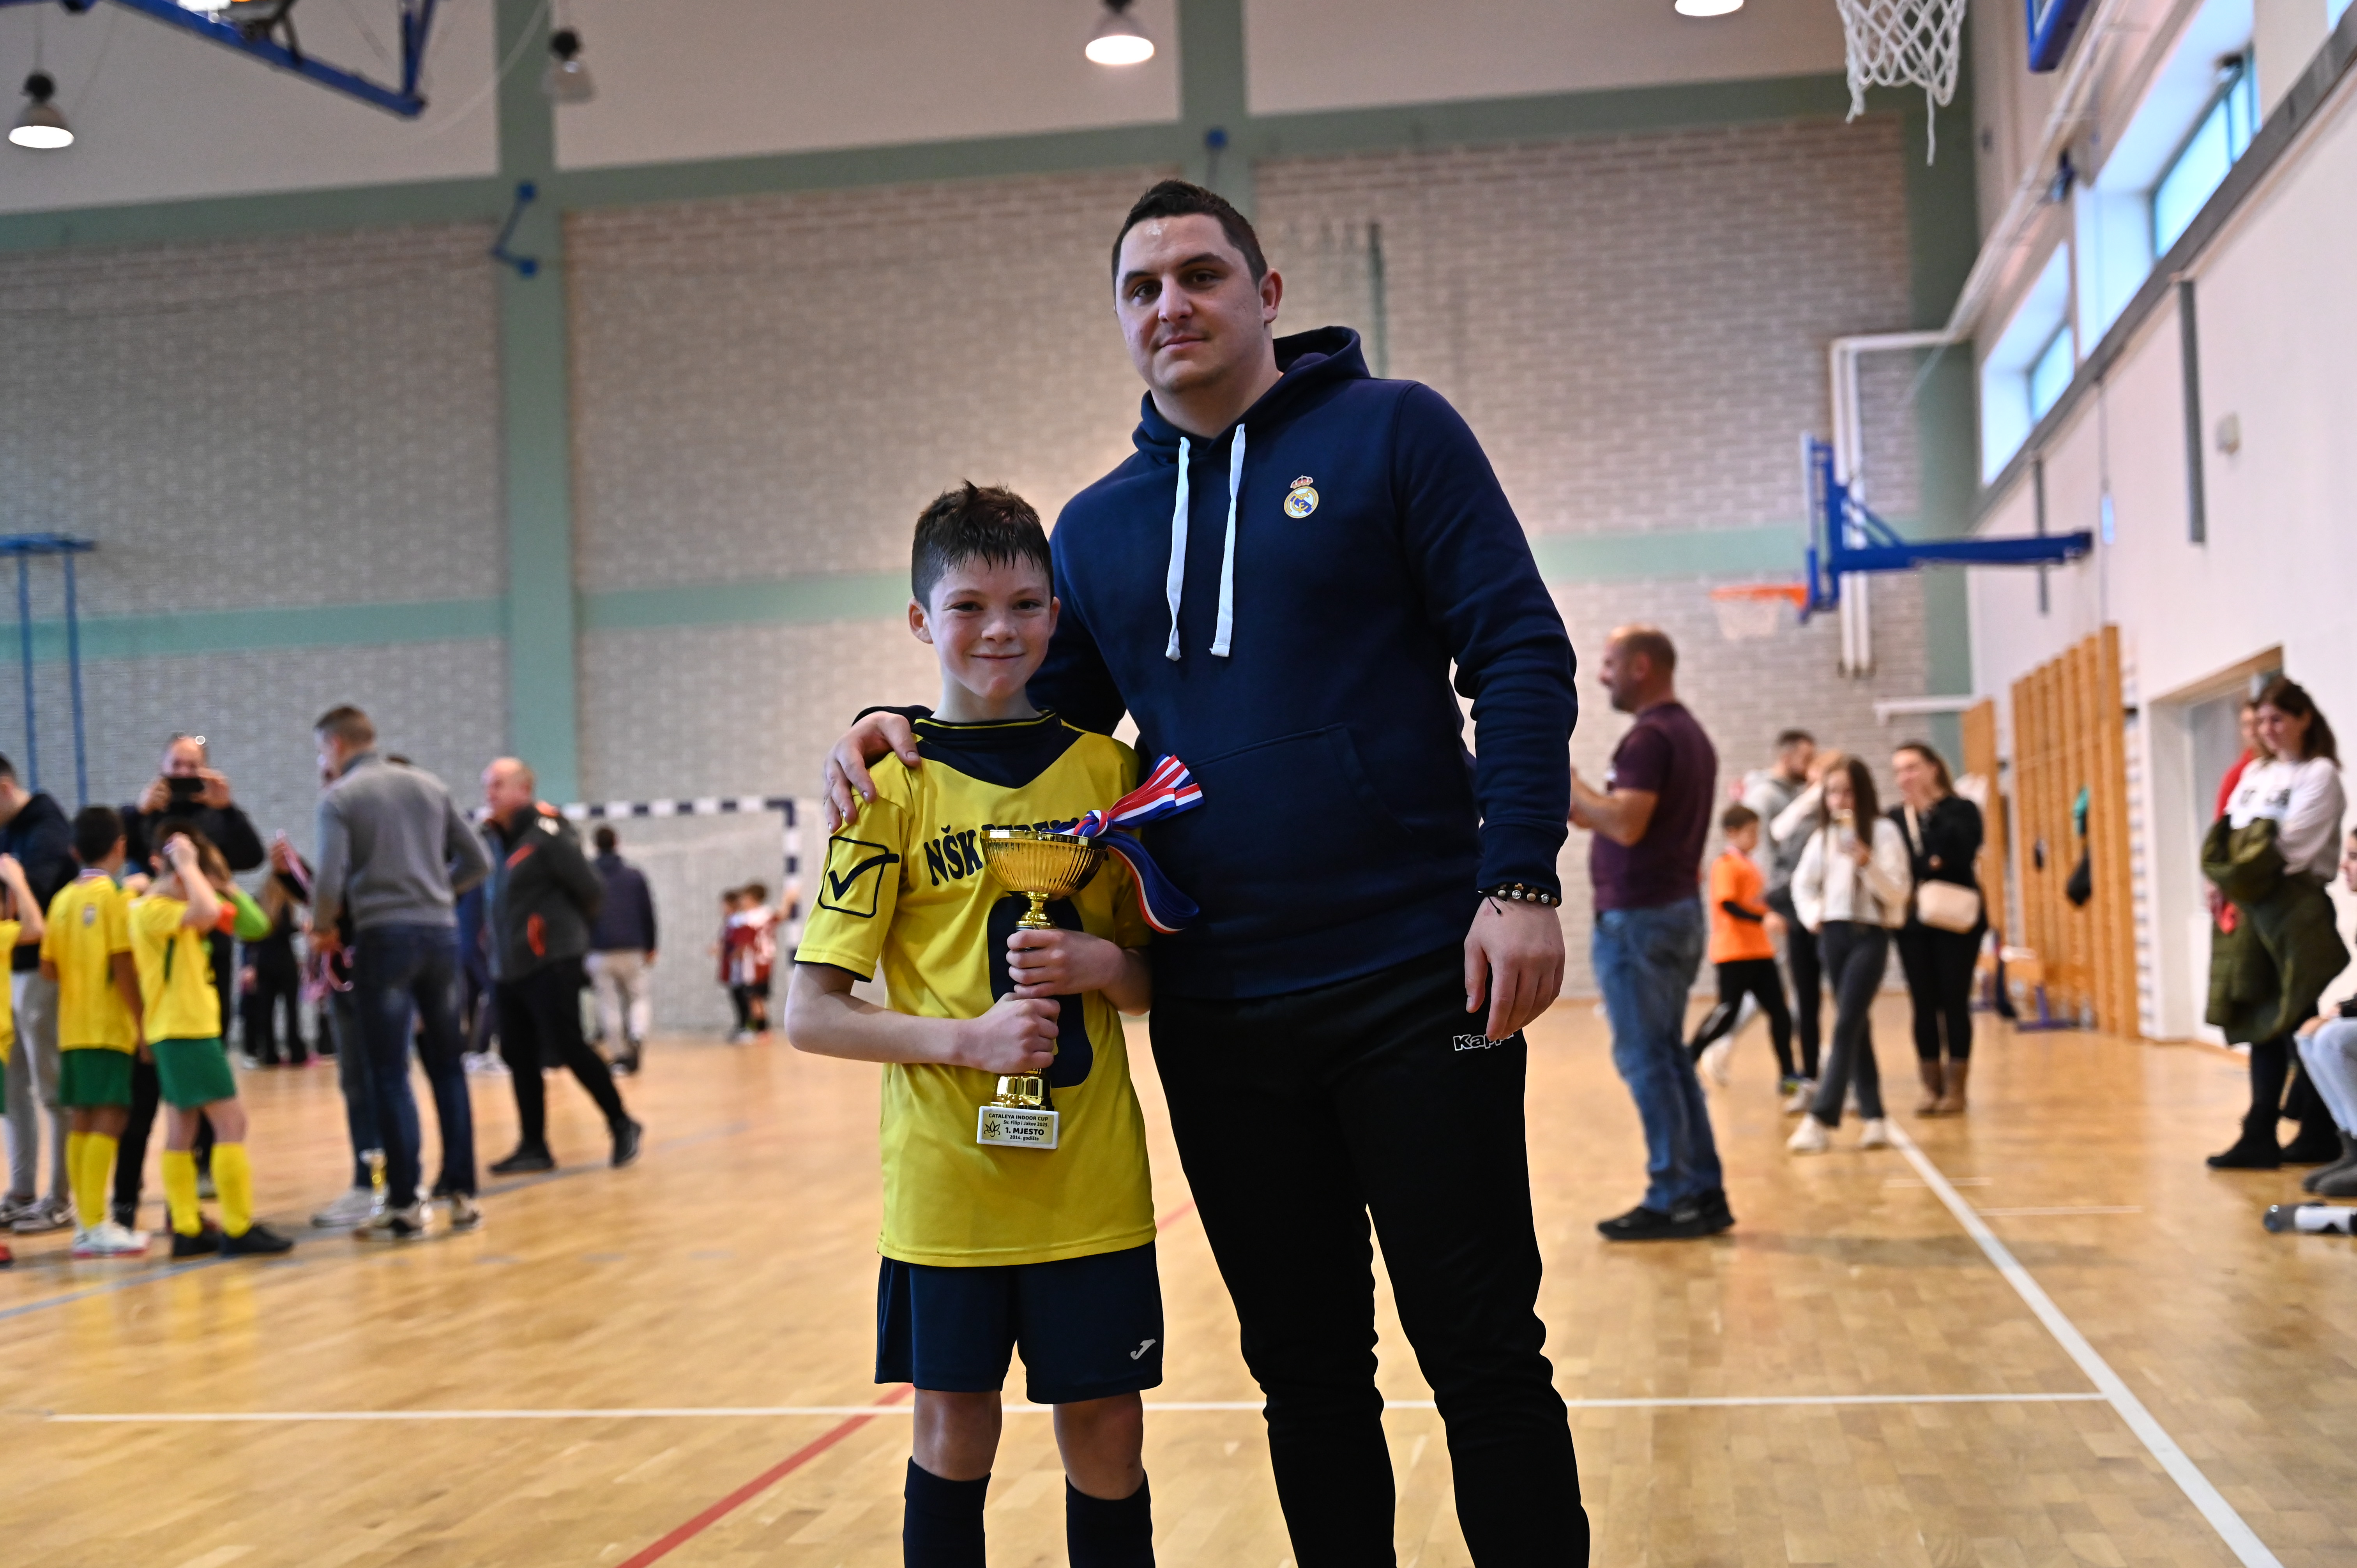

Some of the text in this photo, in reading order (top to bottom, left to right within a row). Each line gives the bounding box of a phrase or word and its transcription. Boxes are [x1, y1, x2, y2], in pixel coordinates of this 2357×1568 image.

[924, 825, 983, 886] NŠK
[1453, 1033, 1514, 1051] Kap
[1012, 1127, 1044, 1135] MJESTO
